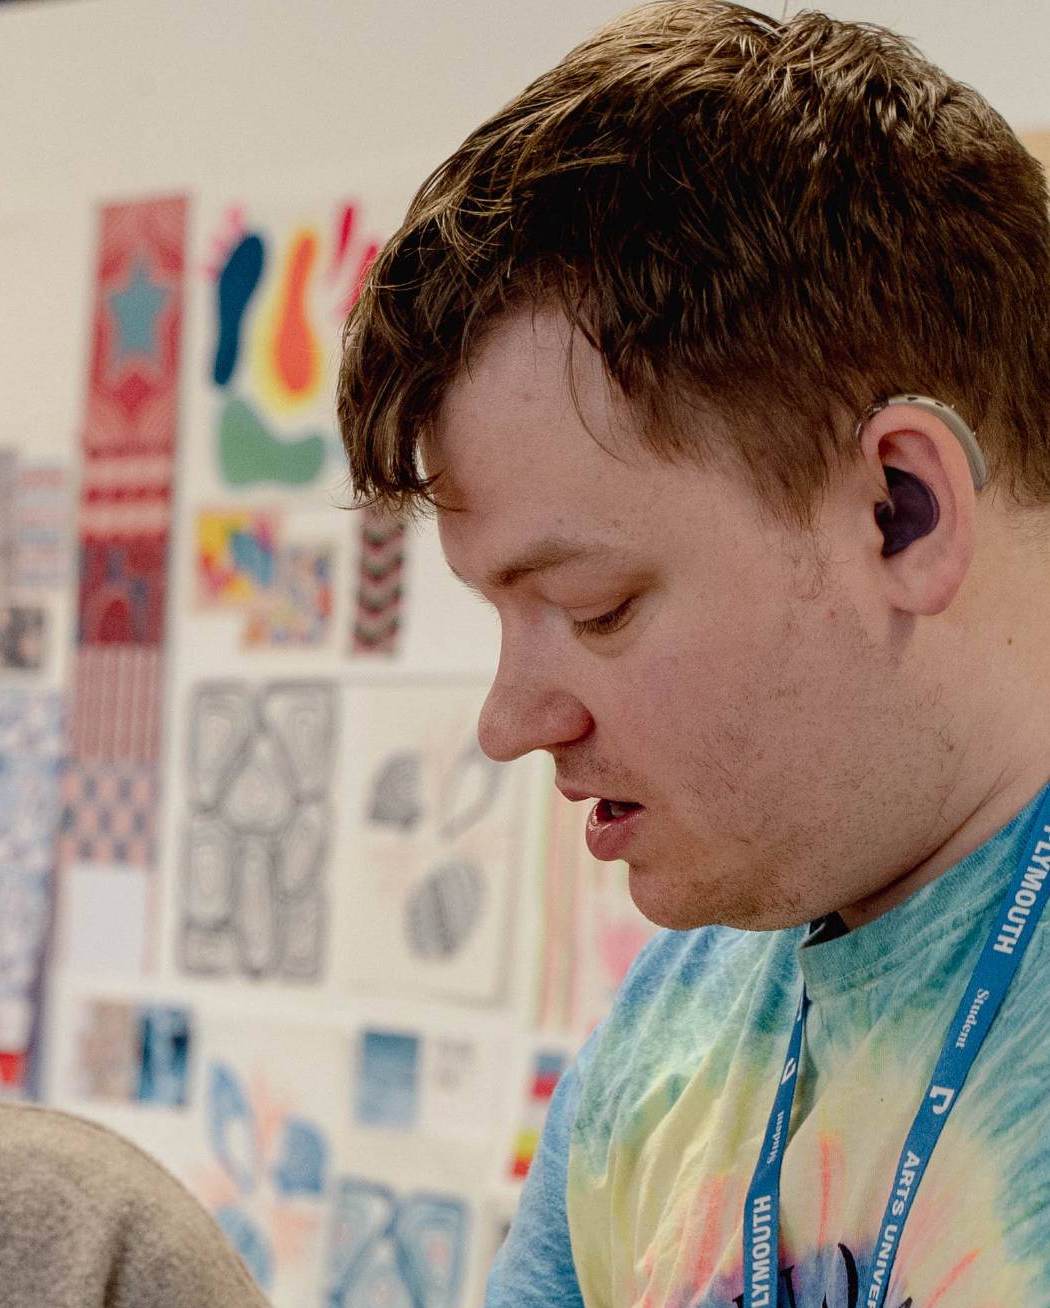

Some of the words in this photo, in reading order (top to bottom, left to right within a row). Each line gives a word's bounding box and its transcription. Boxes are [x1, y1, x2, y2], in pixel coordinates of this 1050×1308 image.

[956, 988, 990, 1050] Student
[767, 1111, 785, 1165] Student
[892, 1150, 920, 1216] ARTS
